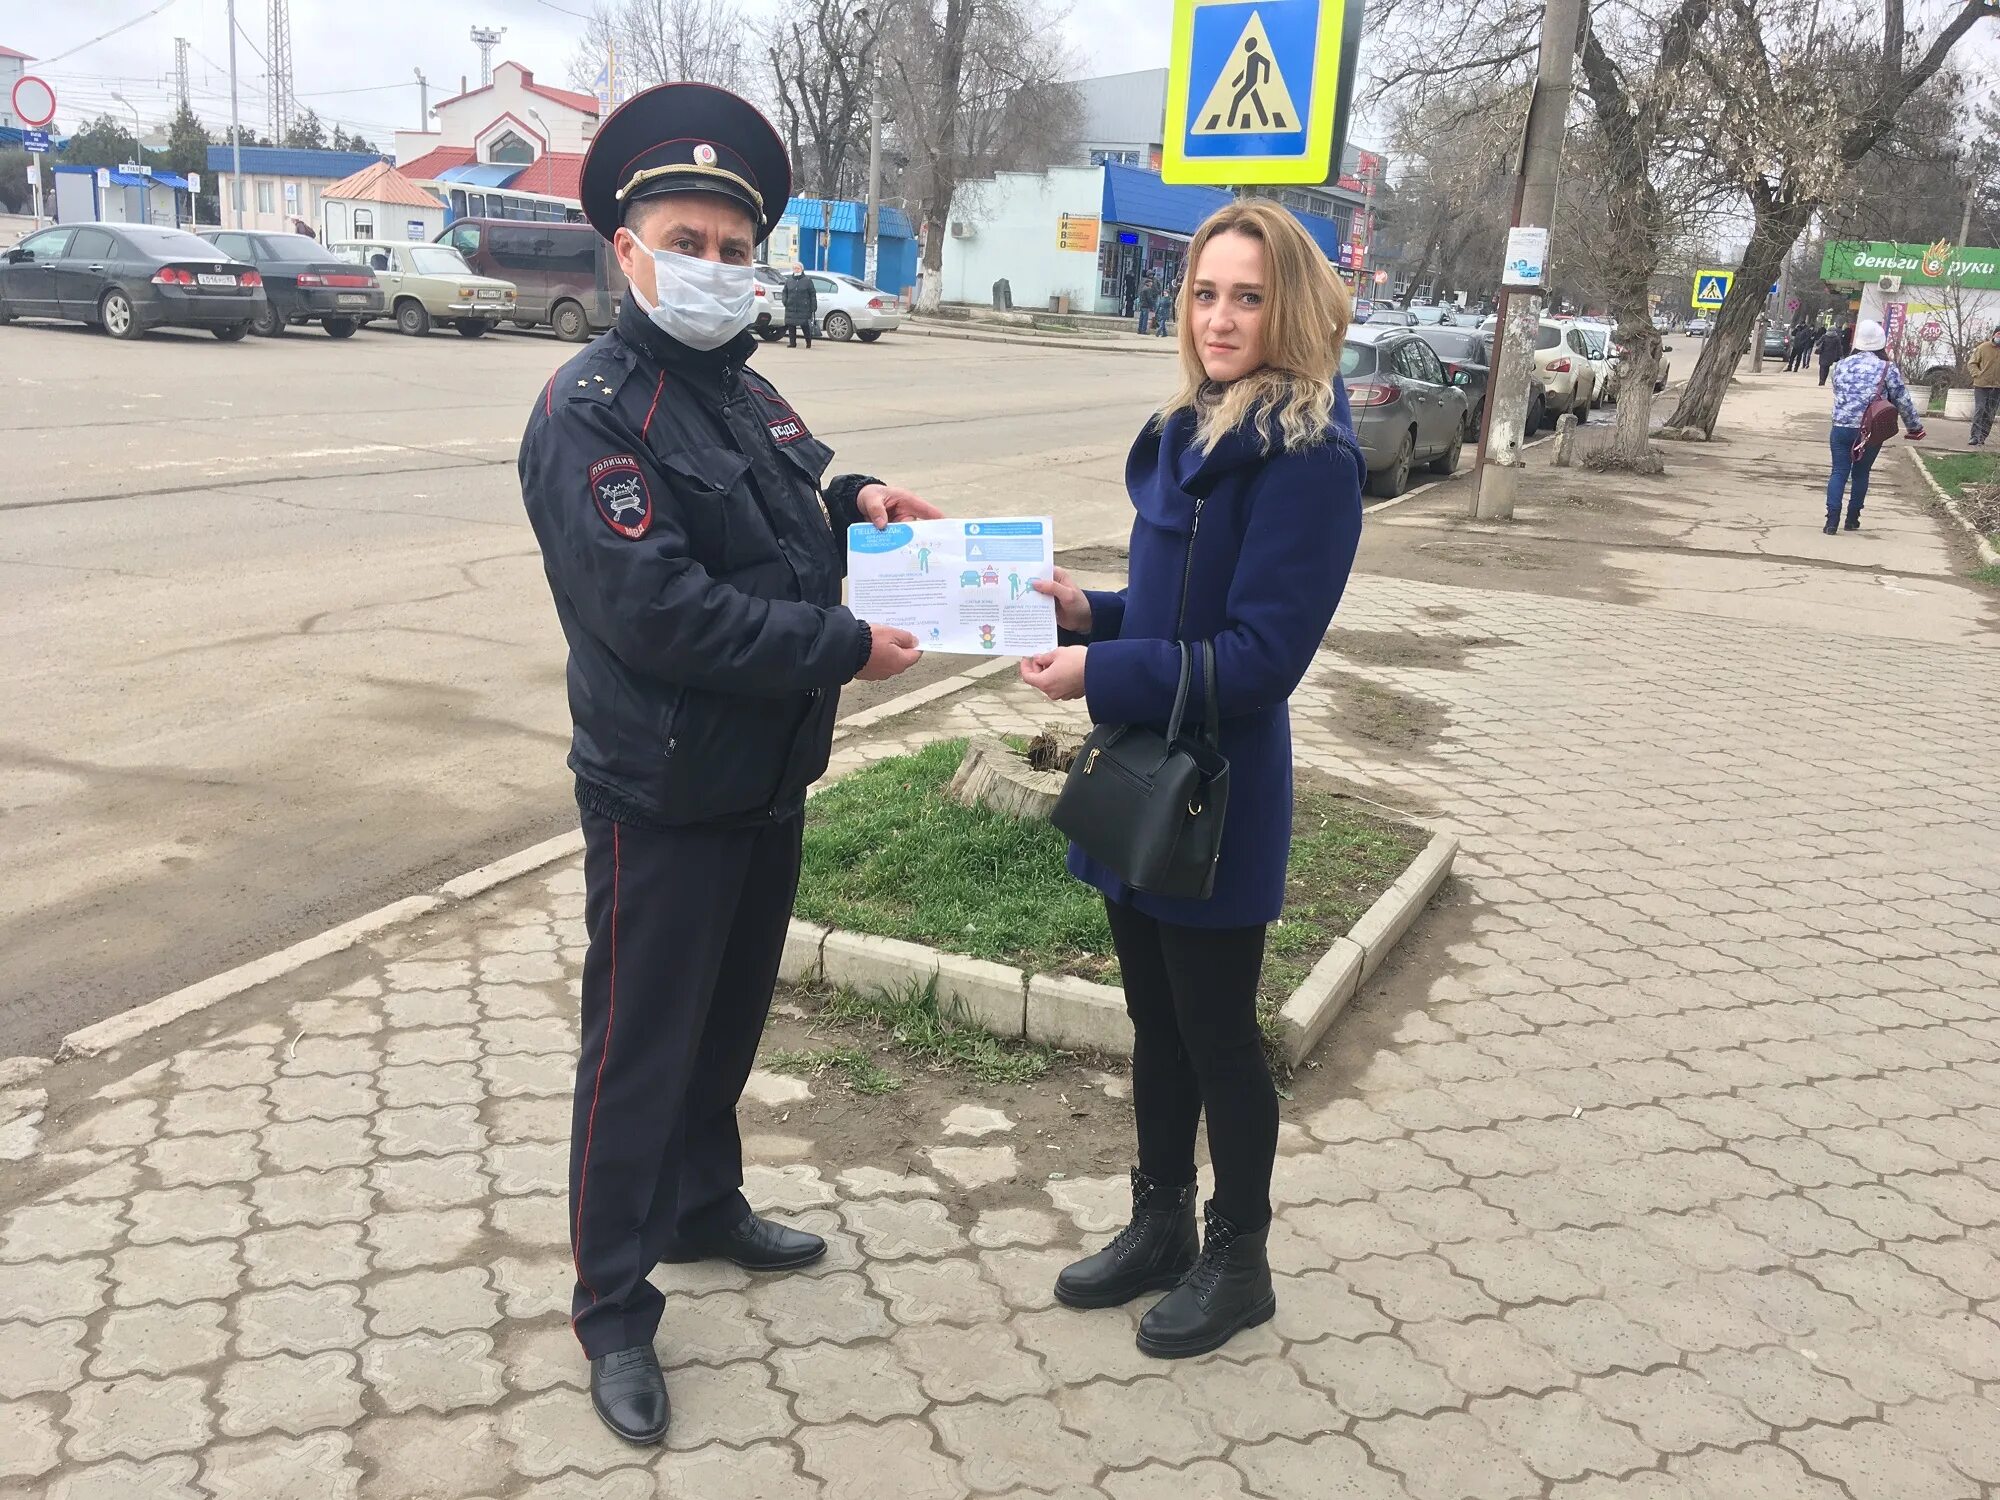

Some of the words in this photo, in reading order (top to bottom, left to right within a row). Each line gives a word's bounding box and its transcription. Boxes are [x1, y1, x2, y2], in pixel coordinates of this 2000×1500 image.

[287, 184, 294, 195] 4
[1854, 252, 1918, 270] деньги
[1947, 260, 1995, 277] руки
[592, 457, 635, 475] ПОЛИЦИЯ
[625, 523, 645, 538] МВД
